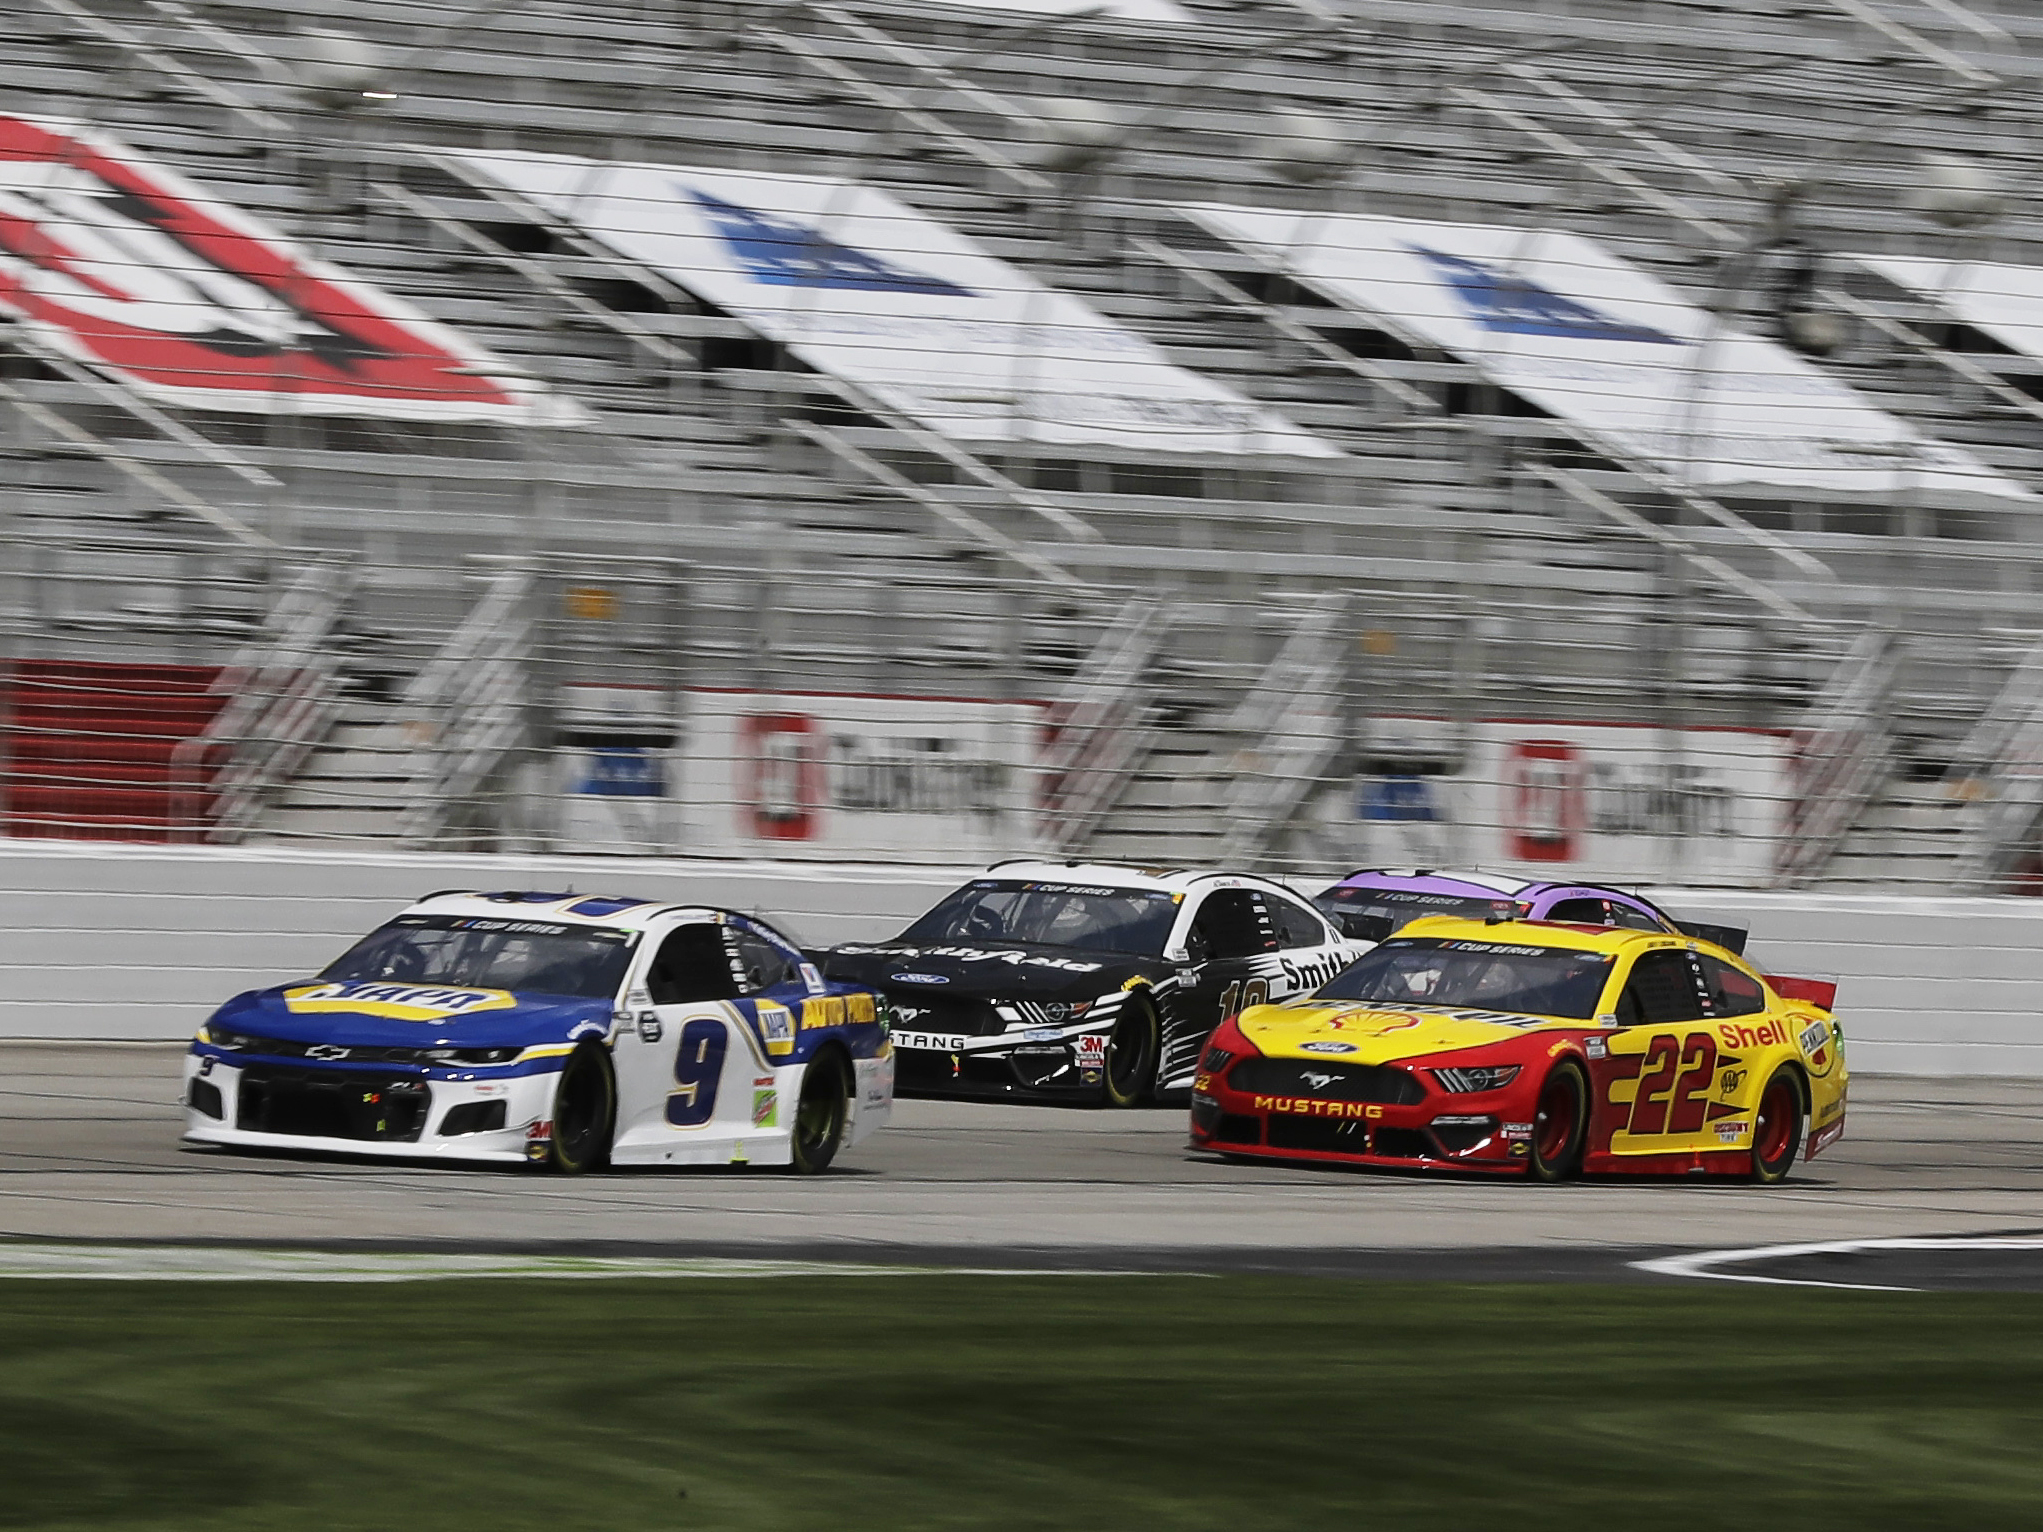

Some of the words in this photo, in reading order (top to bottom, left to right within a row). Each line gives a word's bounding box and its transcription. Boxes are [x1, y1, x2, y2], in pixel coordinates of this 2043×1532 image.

[1039, 884, 1067, 893] CUP
[1065, 886, 1115, 897] SERIES
[1392, 893, 1420, 902] CUP
[1416, 896, 1465, 906] SERIES
[471, 920, 508, 932] CUP
[504, 923, 567, 936] SERIES
[1459, 941, 1491, 954] CUP
[1491, 944, 1546, 958] SERIES
[1279, 951, 1362, 991] Smith
[889, 1032, 965, 1051] STANG
[1718, 1019, 1788, 1049] Shell
[1080, 1036, 1103, 1053] 3M
[198, 1055, 219, 1077] 9
[667, 1016, 729, 1129] 9
[1628, 1031, 1717, 1135] 22
[1254, 1096, 1384, 1119] MUSTANG
